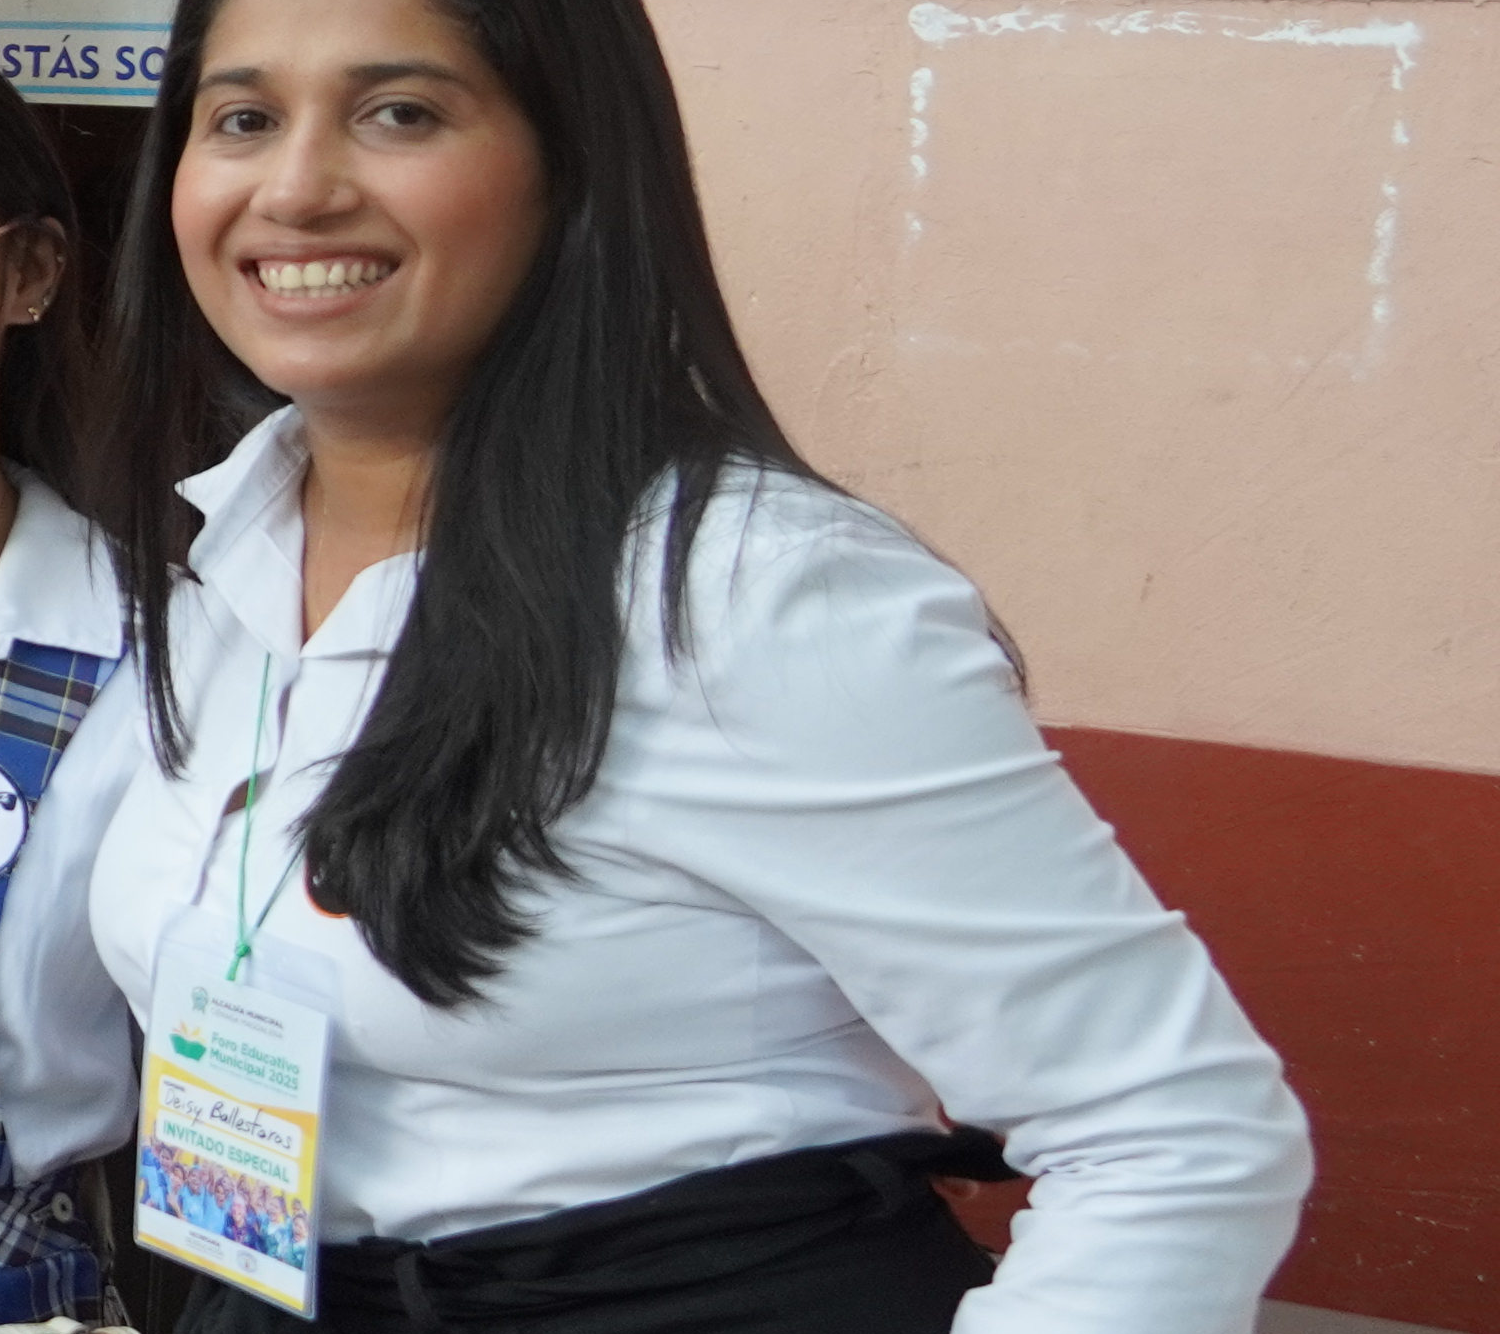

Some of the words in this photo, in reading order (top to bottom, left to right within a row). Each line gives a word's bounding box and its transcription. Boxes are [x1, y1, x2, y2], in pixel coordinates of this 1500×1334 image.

[210, 1047, 265, 1078] Municipal
[268, 1068, 298, 1091] 2025
[211, 1031, 239, 1052] Foro
[241, 1042, 300, 1075] Educativo
[163, 1119, 225, 1156] INVITADO
[228, 1146, 290, 1184] ESPECIAL
